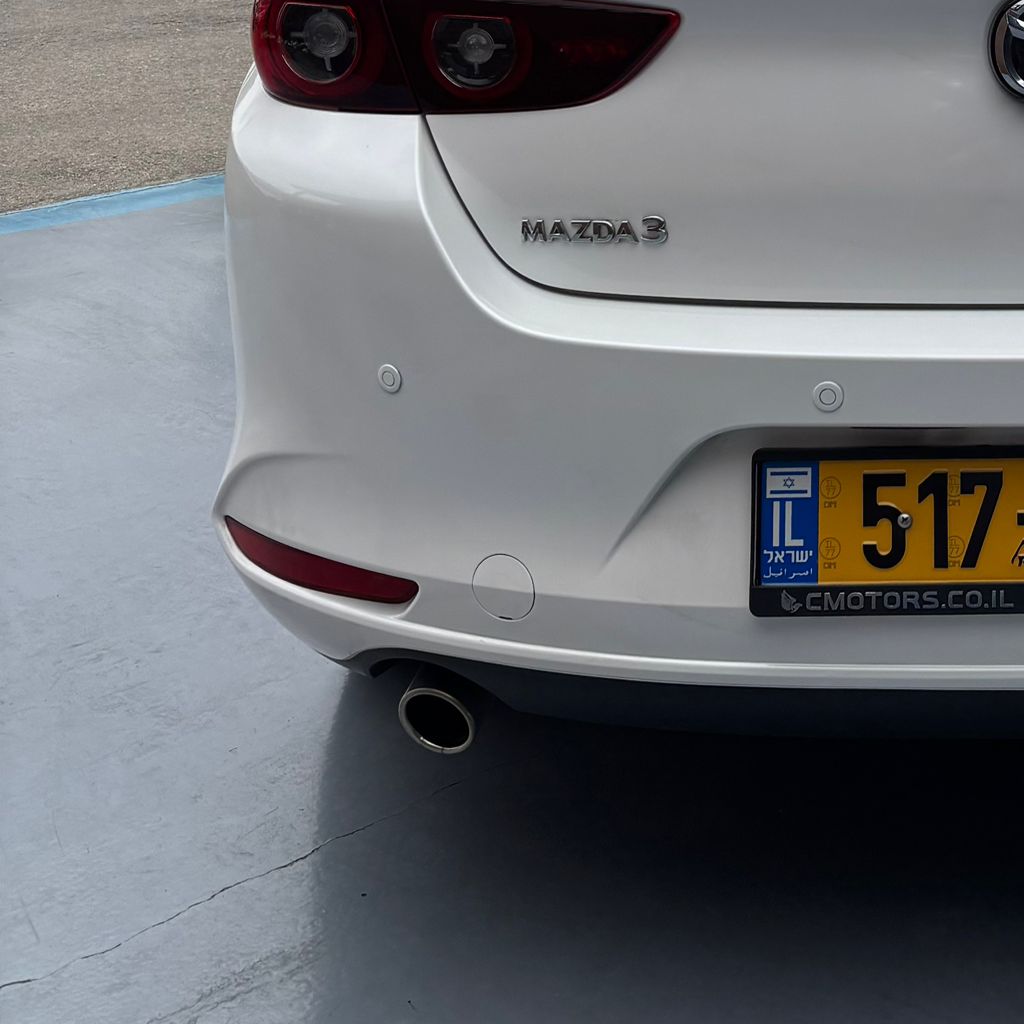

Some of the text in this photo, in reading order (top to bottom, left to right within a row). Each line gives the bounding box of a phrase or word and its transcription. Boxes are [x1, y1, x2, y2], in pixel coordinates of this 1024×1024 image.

[773, 501, 804, 547] IL
[763, 549, 813, 563] ישראל
[805, 589, 1014, 611] CMOTORS.CO.IL
